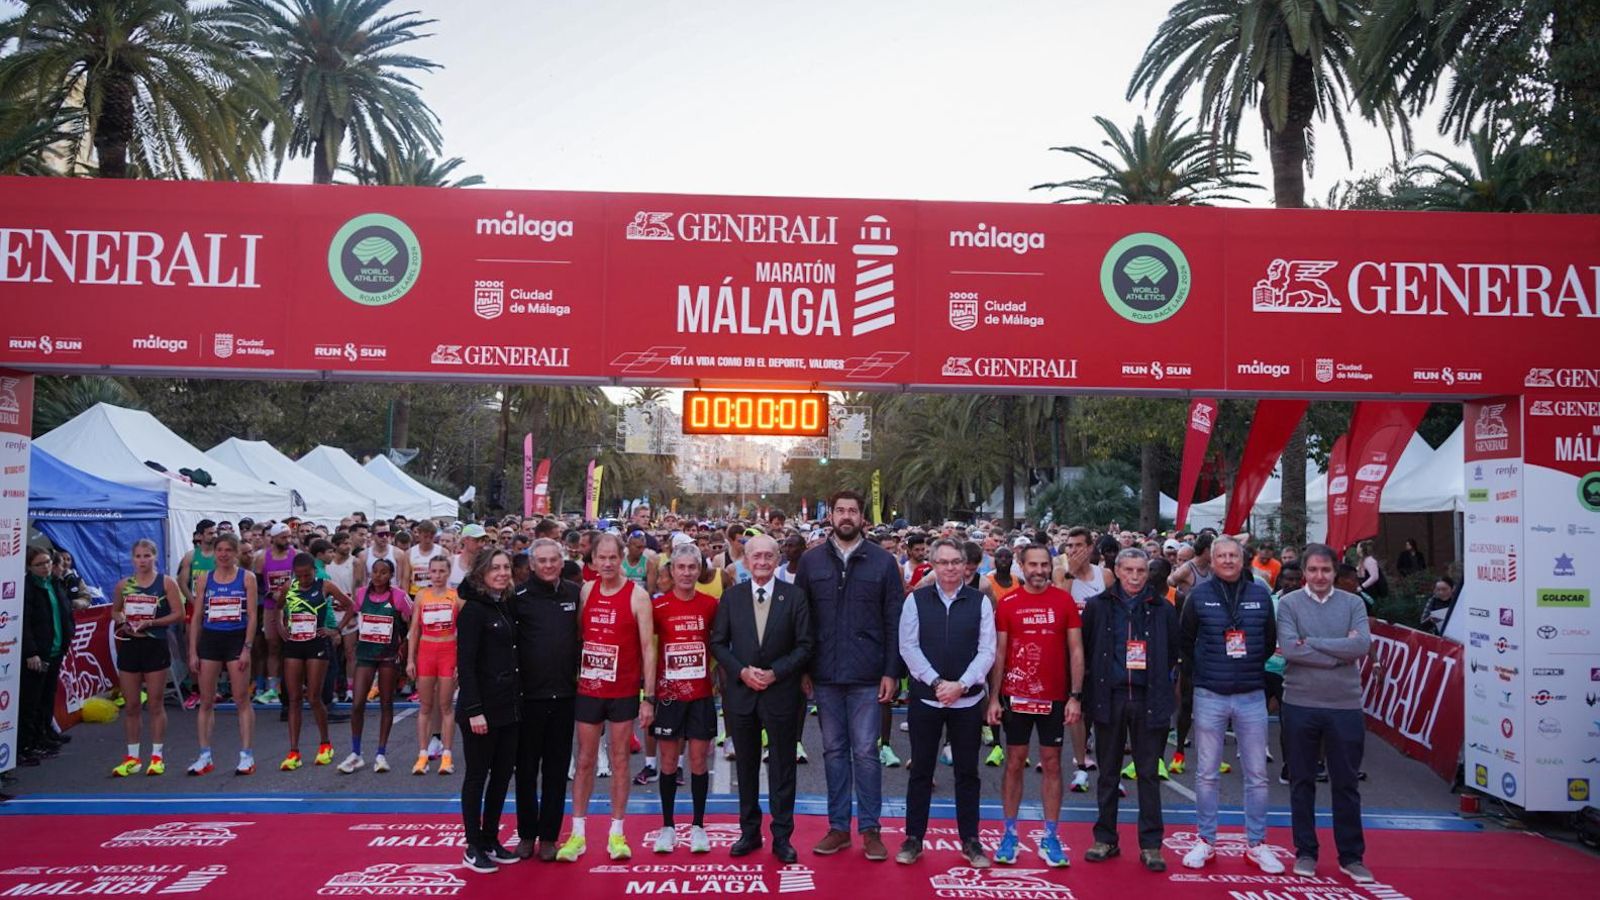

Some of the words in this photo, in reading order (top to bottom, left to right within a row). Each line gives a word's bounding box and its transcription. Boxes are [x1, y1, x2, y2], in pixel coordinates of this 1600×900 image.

[476, 210, 573, 242] málaga
[678, 213, 838, 245] GENERALI
[950, 223, 1045, 254] málaga
[0, 228, 263, 288] ENERALI
[354, 274, 395, 283] ATHLETICS
[756, 259, 835, 284] MARATÓN
[359, 294, 381, 302] ROAD
[382, 288, 402, 301] RACE
[511, 288, 552, 300] Ciudad
[510, 303, 525, 314] de
[528, 302, 570, 316] Málaga
[677, 276, 841, 336] MÁLAGA
[984, 300, 1026, 312] Ciudad
[1132, 312, 1152, 320] ROAD
[1154, 306, 1173, 319] RACE
[984, 314, 999, 325] de
[1002, 314, 1044, 327] Málaga
[8, 339, 36, 350] RUN
[40, 336, 52, 354] &
[56, 340, 82, 350] SUN
[132, 334, 188, 352] málaga
[248, 347, 274, 356] Málaga
[314, 346, 341, 357] RUN
[344, 342, 357, 362] &
[360, 348, 386, 358] SUN
[465, 346, 570, 367] GENERALI
[671, 356, 682, 365] EN
[684, 356, 694, 365] LA
[696, 356, 715, 366] VIDA
[718, 356, 742, 366] COMO
[744, 357, 755, 367] EN
[757, 358, 766, 367] EL
[769, 358, 806, 369] DEPORTE,
[809, 358, 844, 369] VALORES
[975, 357, 1077, 378] GENERALI
[1237, 360, 1290, 378] málaga
[1122, 365, 1147, 375] RUN
[1150, 361, 1163, 379] &
[1166, 366, 1192, 375] SUN
[1347, 372, 1372, 380] Málaga
[1414, 370, 1439, 380] RUN
[1441, 366, 1454, 385] &
[1457, 372, 1482, 381] SUN
[692, 397, 818, 429] 00:00:00
[1476, 438, 1508, 452] GENERALI
[1555, 432, 1600, 461] MÁL
[1496, 464, 1518, 477] renfe
[587, 655, 608, 665] 17914
[674, 655, 697, 663] 17913
[100, 839, 229, 848] GENERALI
[46, 865, 187, 874] GENERALI
[632, 864, 764, 872] GENERALI
[626, 878, 769, 894] MÁLAGA
[1208, 874, 1340, 884] GENERALI
[0, 880, 158, 896] MÁLAGA
[316, 886, 462, 896] GENERALI
[936, 889, 1077, 900] GENERALI
